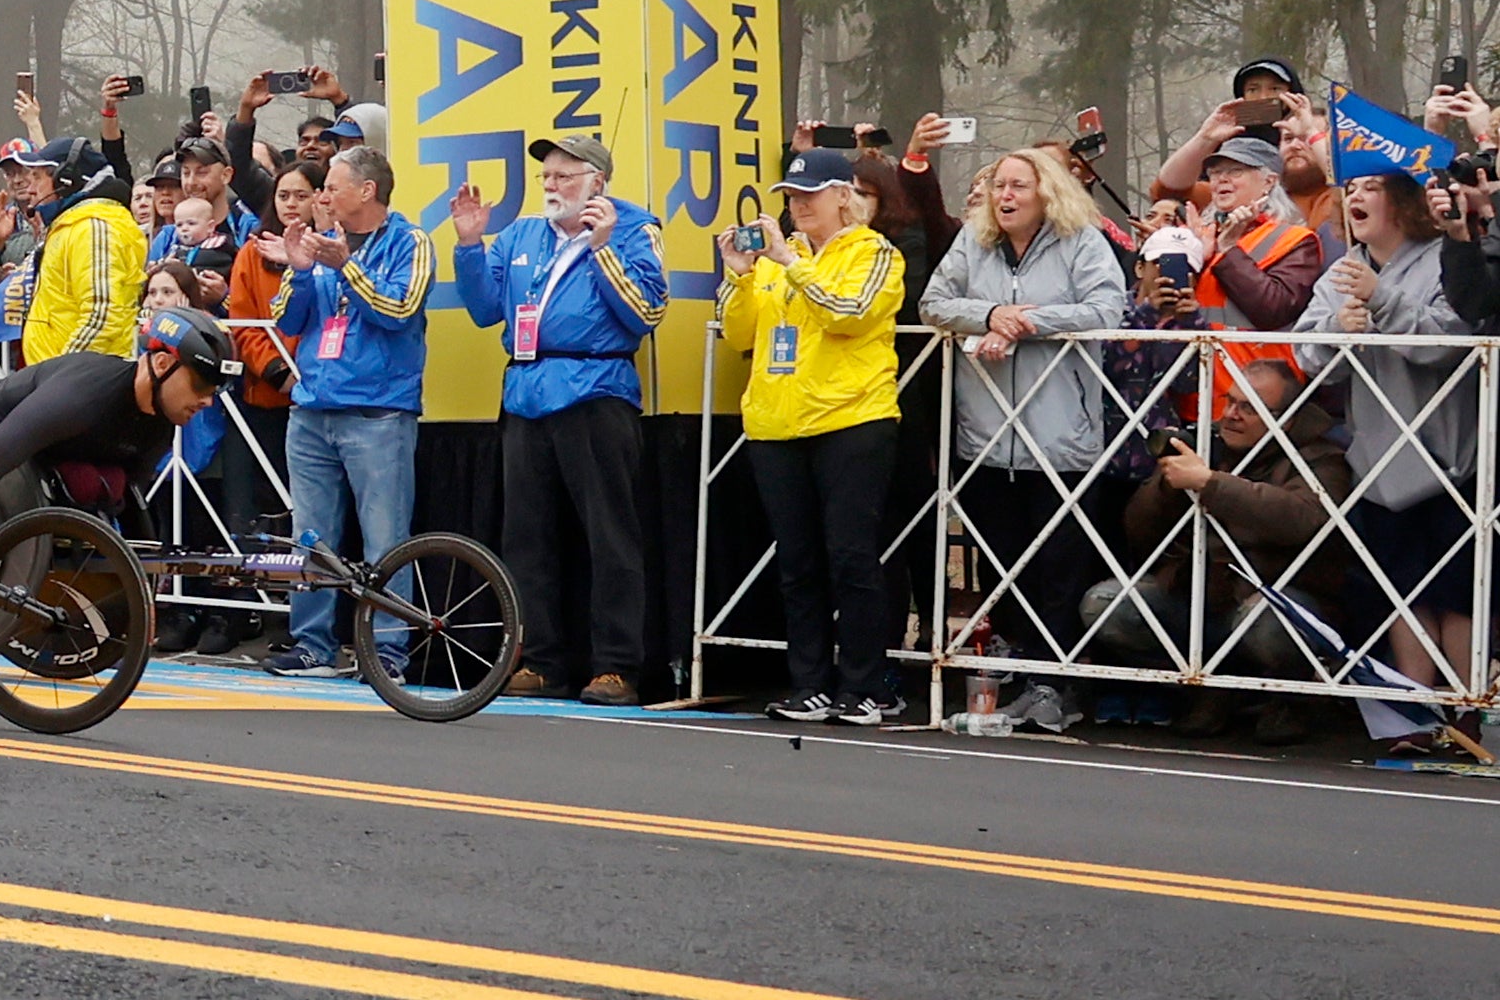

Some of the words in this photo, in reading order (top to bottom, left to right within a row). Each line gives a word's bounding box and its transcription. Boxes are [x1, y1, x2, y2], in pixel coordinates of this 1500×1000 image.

[4, 258, 30, 326] TRONG
[157, 318, 180, 337] W4
[257, 553, 305, 566] SMITH
